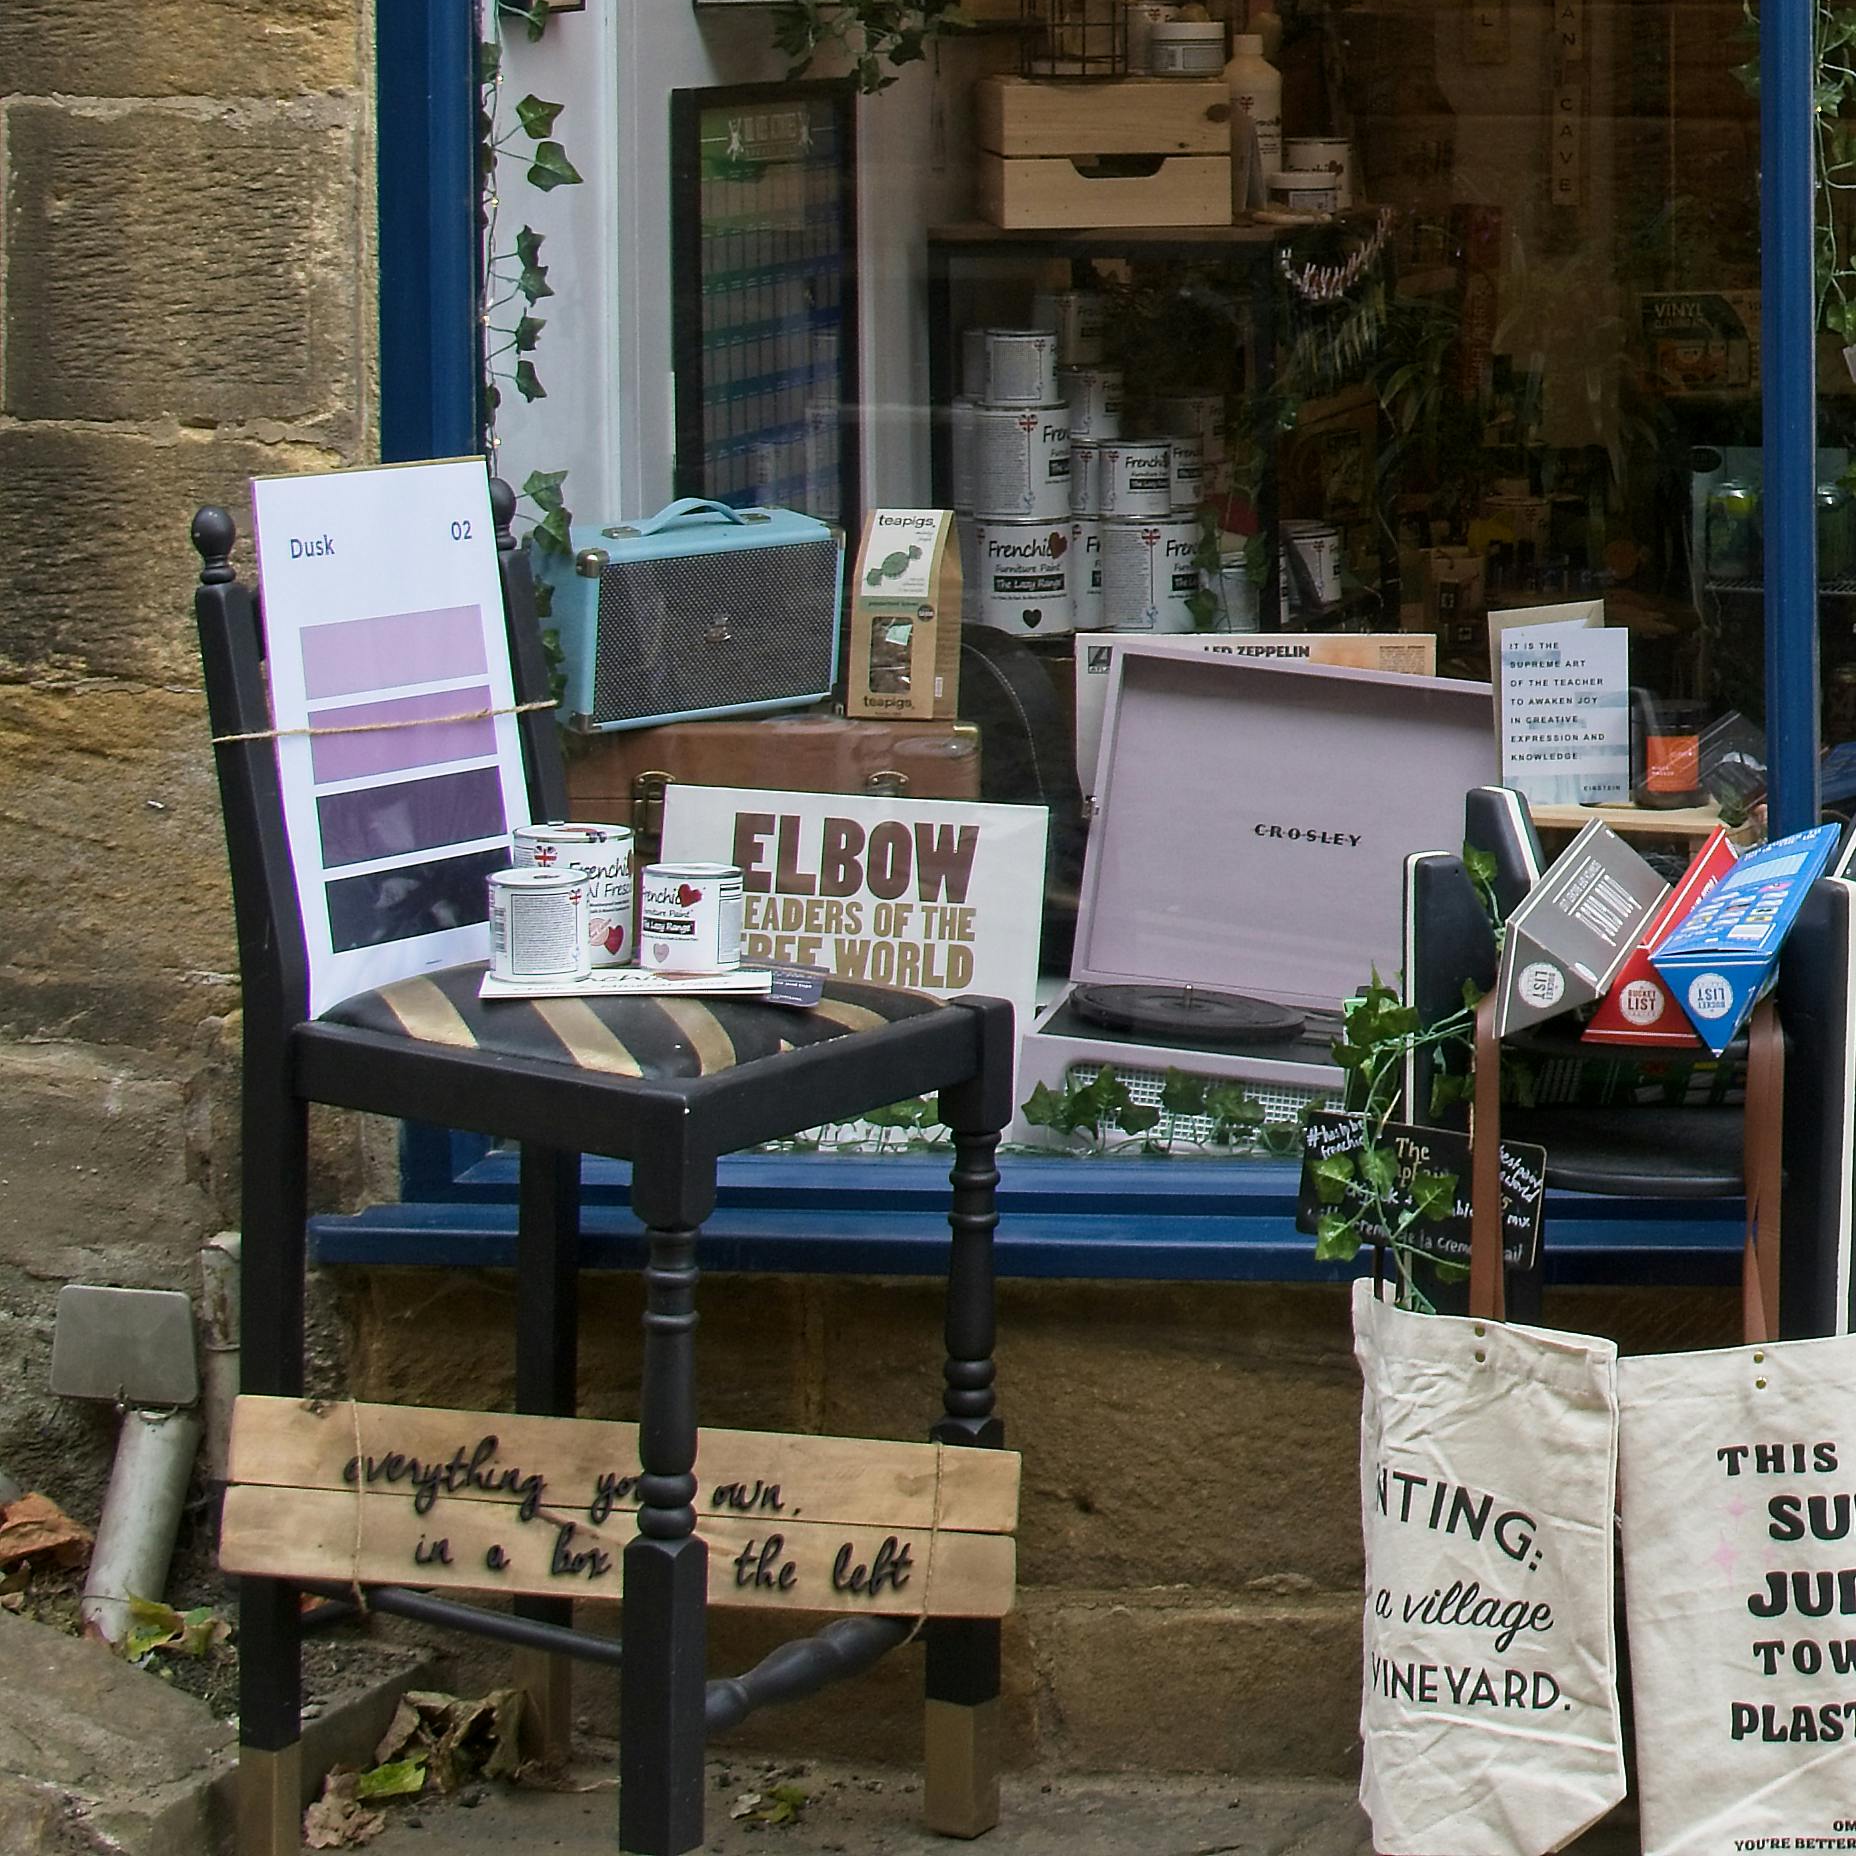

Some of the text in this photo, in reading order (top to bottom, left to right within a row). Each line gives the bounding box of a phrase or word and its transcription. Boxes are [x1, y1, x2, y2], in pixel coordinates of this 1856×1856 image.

[878, 514, 936, 529] teapigs.
[289, 520, 473, 562] Dusk 02
[1237, 646, 1311, 659] ZEPPELIN
[1540, 642, 1559, 650] THE
[1509, 660, 1586, 669] SUPREME ART
[1510, 679, 1524, 687] OF
[1554, 678, 1603, 686] TEACHER
[1510, 697, 1599, 706] TO AWAKEN JOY
[1525, 716, 1579, 724] CREATIVE
[1510, 733, 1605, 743] EXPRESSION AND
[1254, 822, 1363, 849] CROSLEY
[733, 811, 980, 905] ELBOW
[875, 904, 976, 943] OF THE
[834, 939, 976, 990] WORLD
[1533, 969, 1549, 1000] LIST
[1697, 982, 1725, 995] LIST
[1627, 988, 1657, 999] BUCKET
[1627, 998, 1657, 1011] LIST
[1396, 1137, 1431, 1161] The
[1507, 1214, 1531, 1228] mix
[1420, 1234, 1432, 1250] la
[1717, 1441, 1839, 1477] THIS
[343, 1435, 547, 1524] everything
[415, 1529, 456, 1568] in
[486, 1545, 513, 1575] a
[550, 1537, 613, 1581] box
[734, 1532, 798, 1590] the
[1376, 1579, 1555, 1654] a village
[1371, 1659, 1572, 1712] VINEYARD.
[1735, 1835, 1792, 1853] YOU'RE
[1795, 1837, 1856, 1850] BETTER
